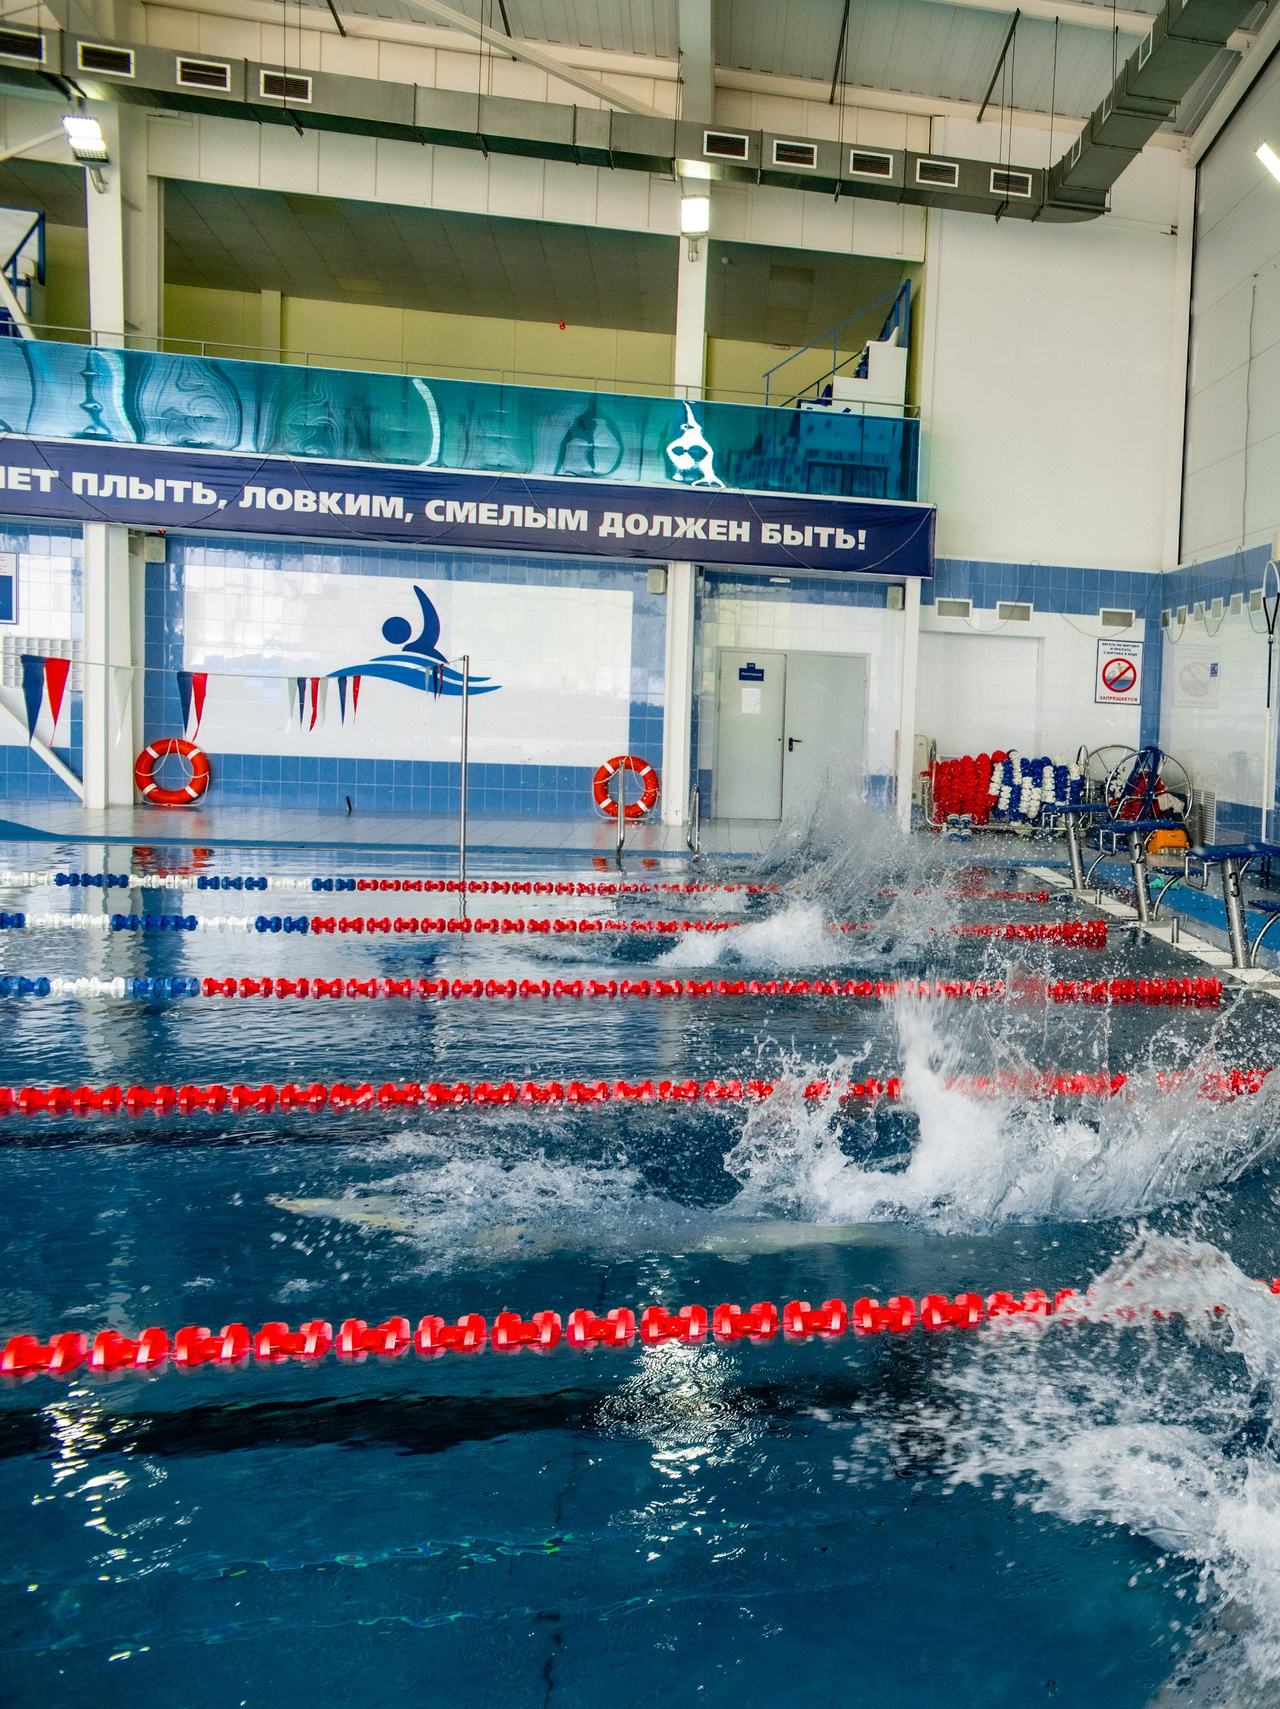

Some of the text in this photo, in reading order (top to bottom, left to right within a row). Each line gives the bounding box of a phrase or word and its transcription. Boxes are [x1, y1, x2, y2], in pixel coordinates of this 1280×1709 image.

[0, 466, 866, 550] ЕТ ПЛЫТЬ, ЛОВКИМ, СМЕЛЫМ ДОЛЖЕН БЫТЬ!
[1134, 843, 1144, 864] 2
[1229, 871, 1240, 897] 3
